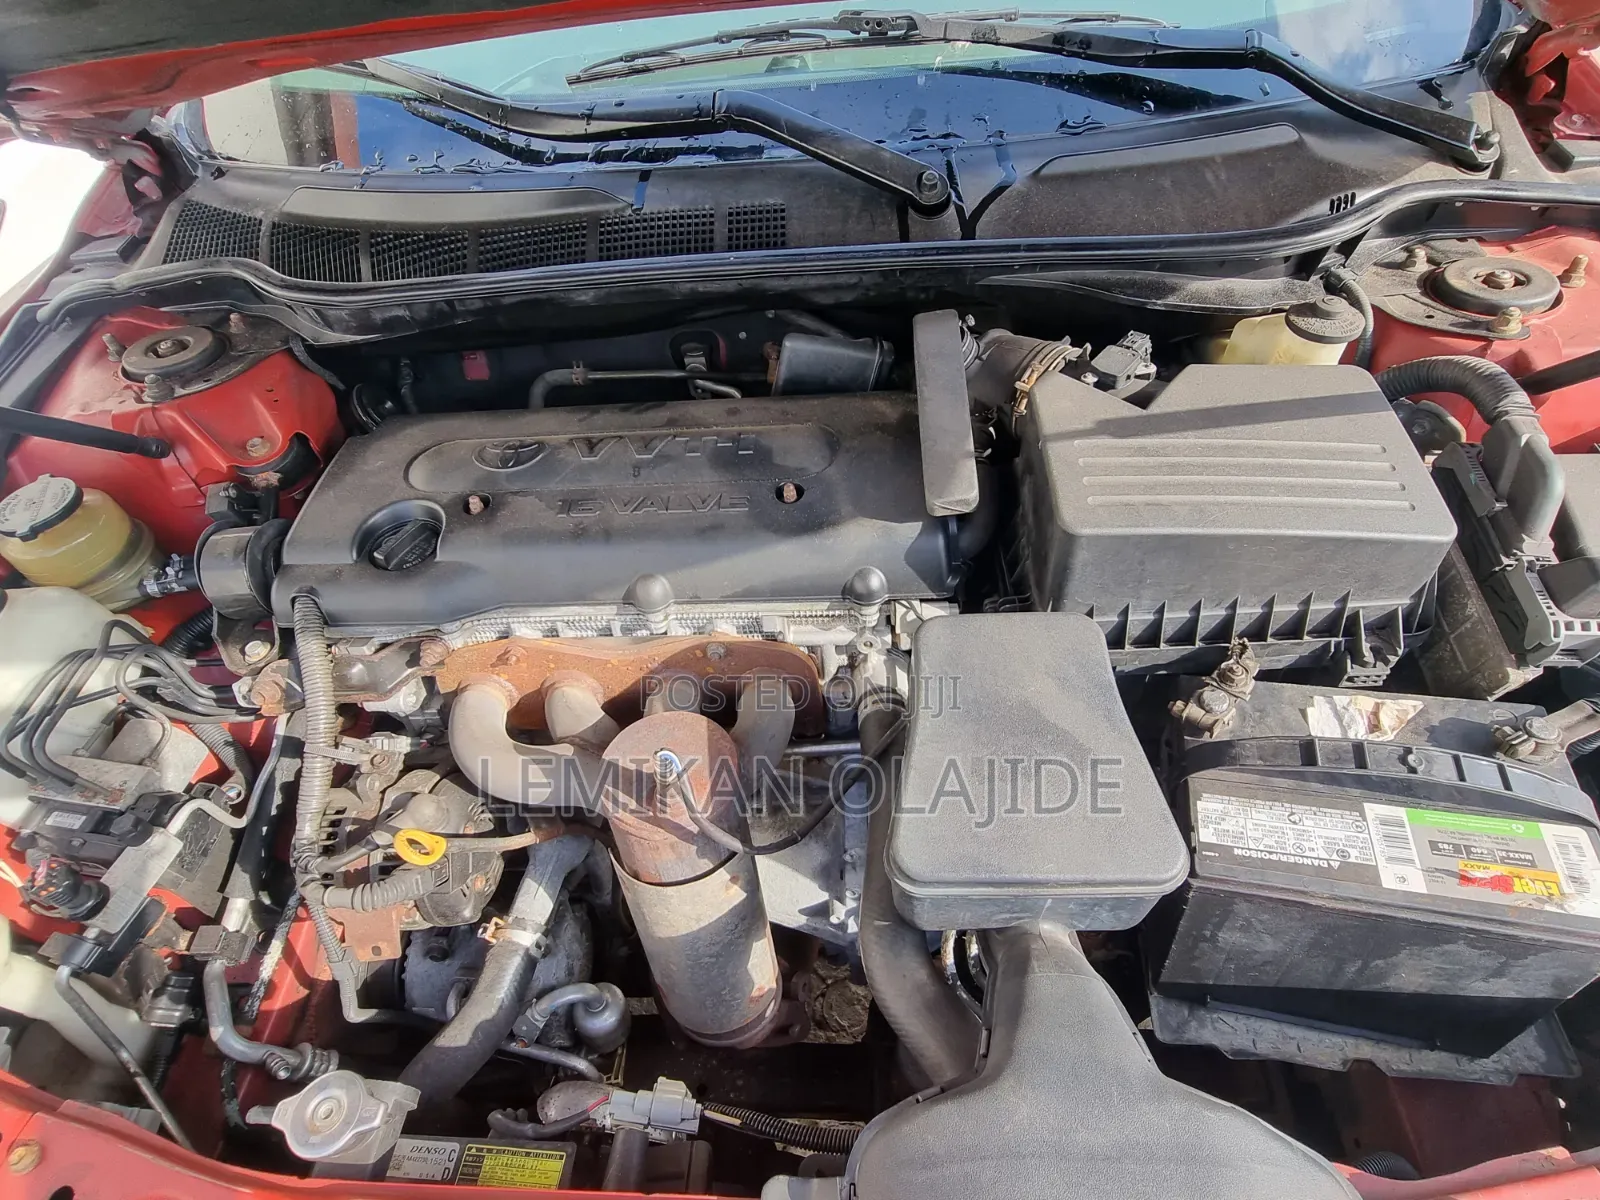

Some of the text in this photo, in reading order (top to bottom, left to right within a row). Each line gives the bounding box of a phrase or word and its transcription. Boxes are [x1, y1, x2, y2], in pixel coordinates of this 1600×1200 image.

[610, 493, 751, 515] VALVE
[410, 1146, 447, 1155] DENSO
[448, 1149, 456, 1162] C
